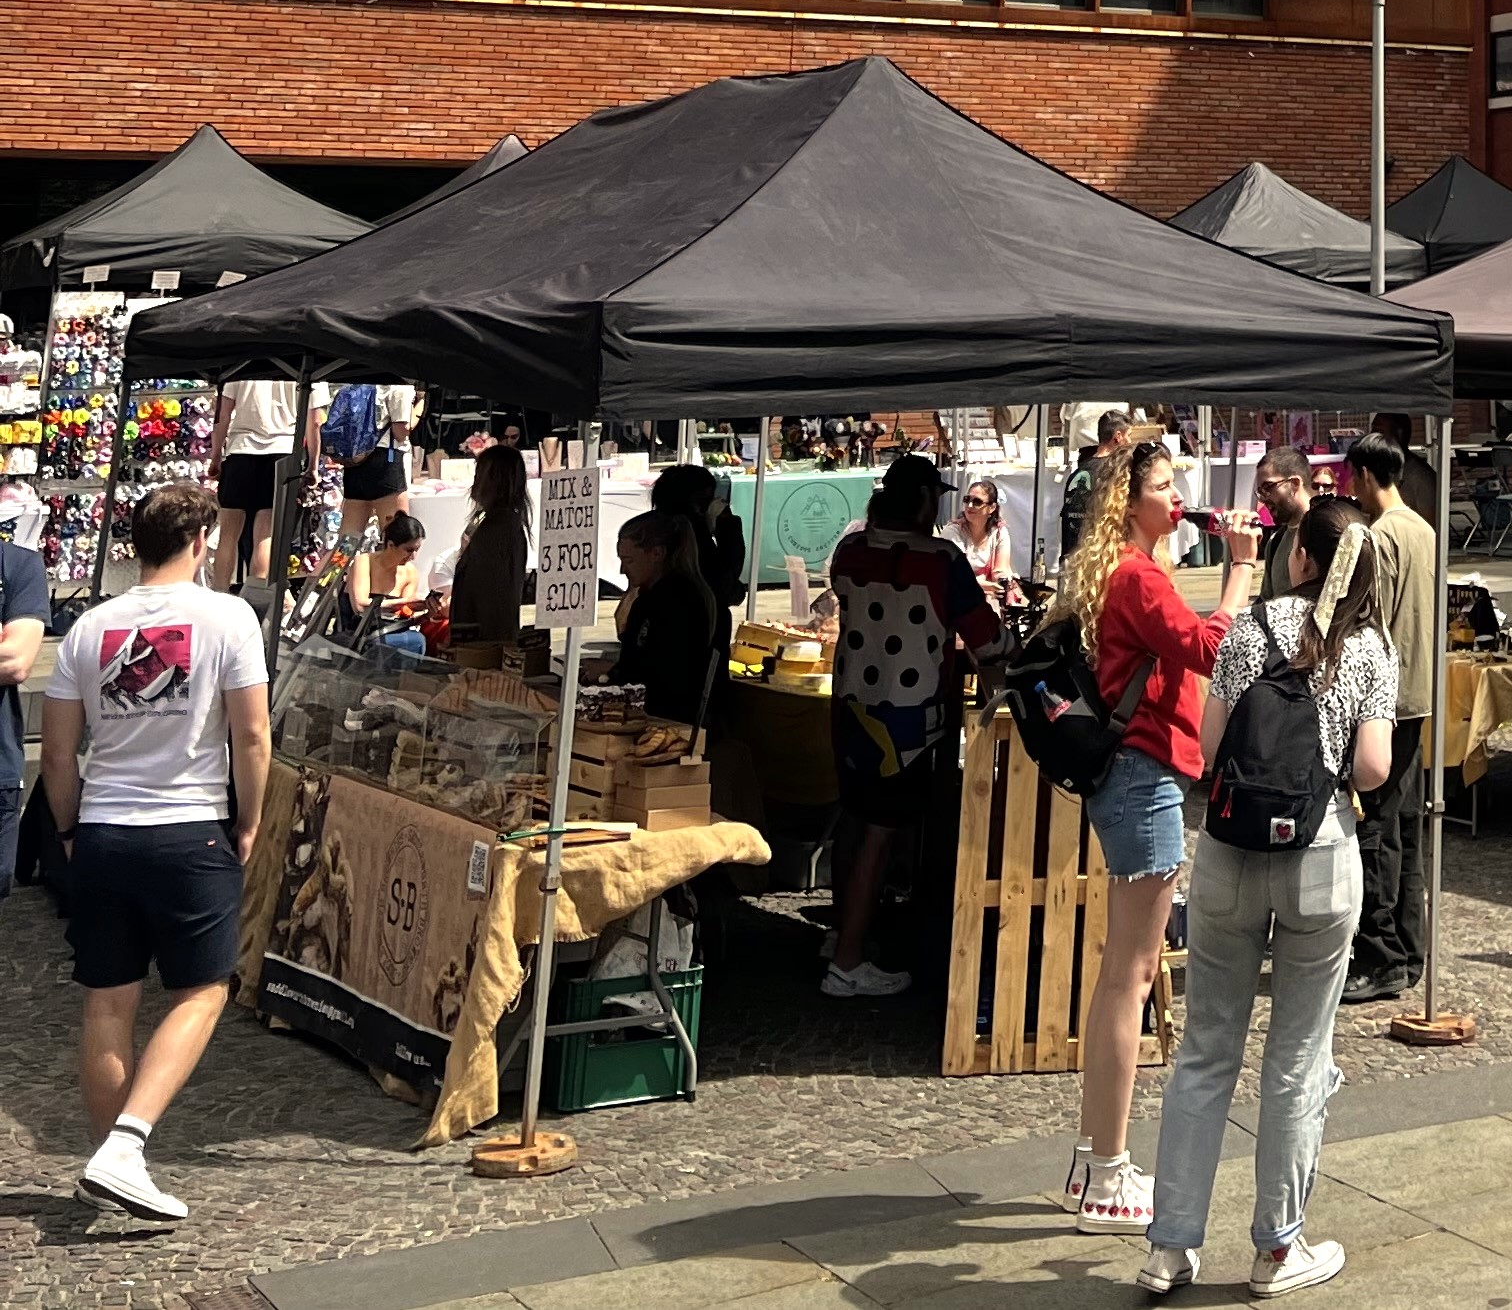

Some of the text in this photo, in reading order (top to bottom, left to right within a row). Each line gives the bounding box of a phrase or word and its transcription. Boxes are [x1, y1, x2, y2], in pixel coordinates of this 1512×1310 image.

[548, 475, 593, 500] MIX &
[544, 505, 594, 531] MATCH
[541, 542, 593, 573] 3 FOR
[545, 582, 586, 612] £10!
